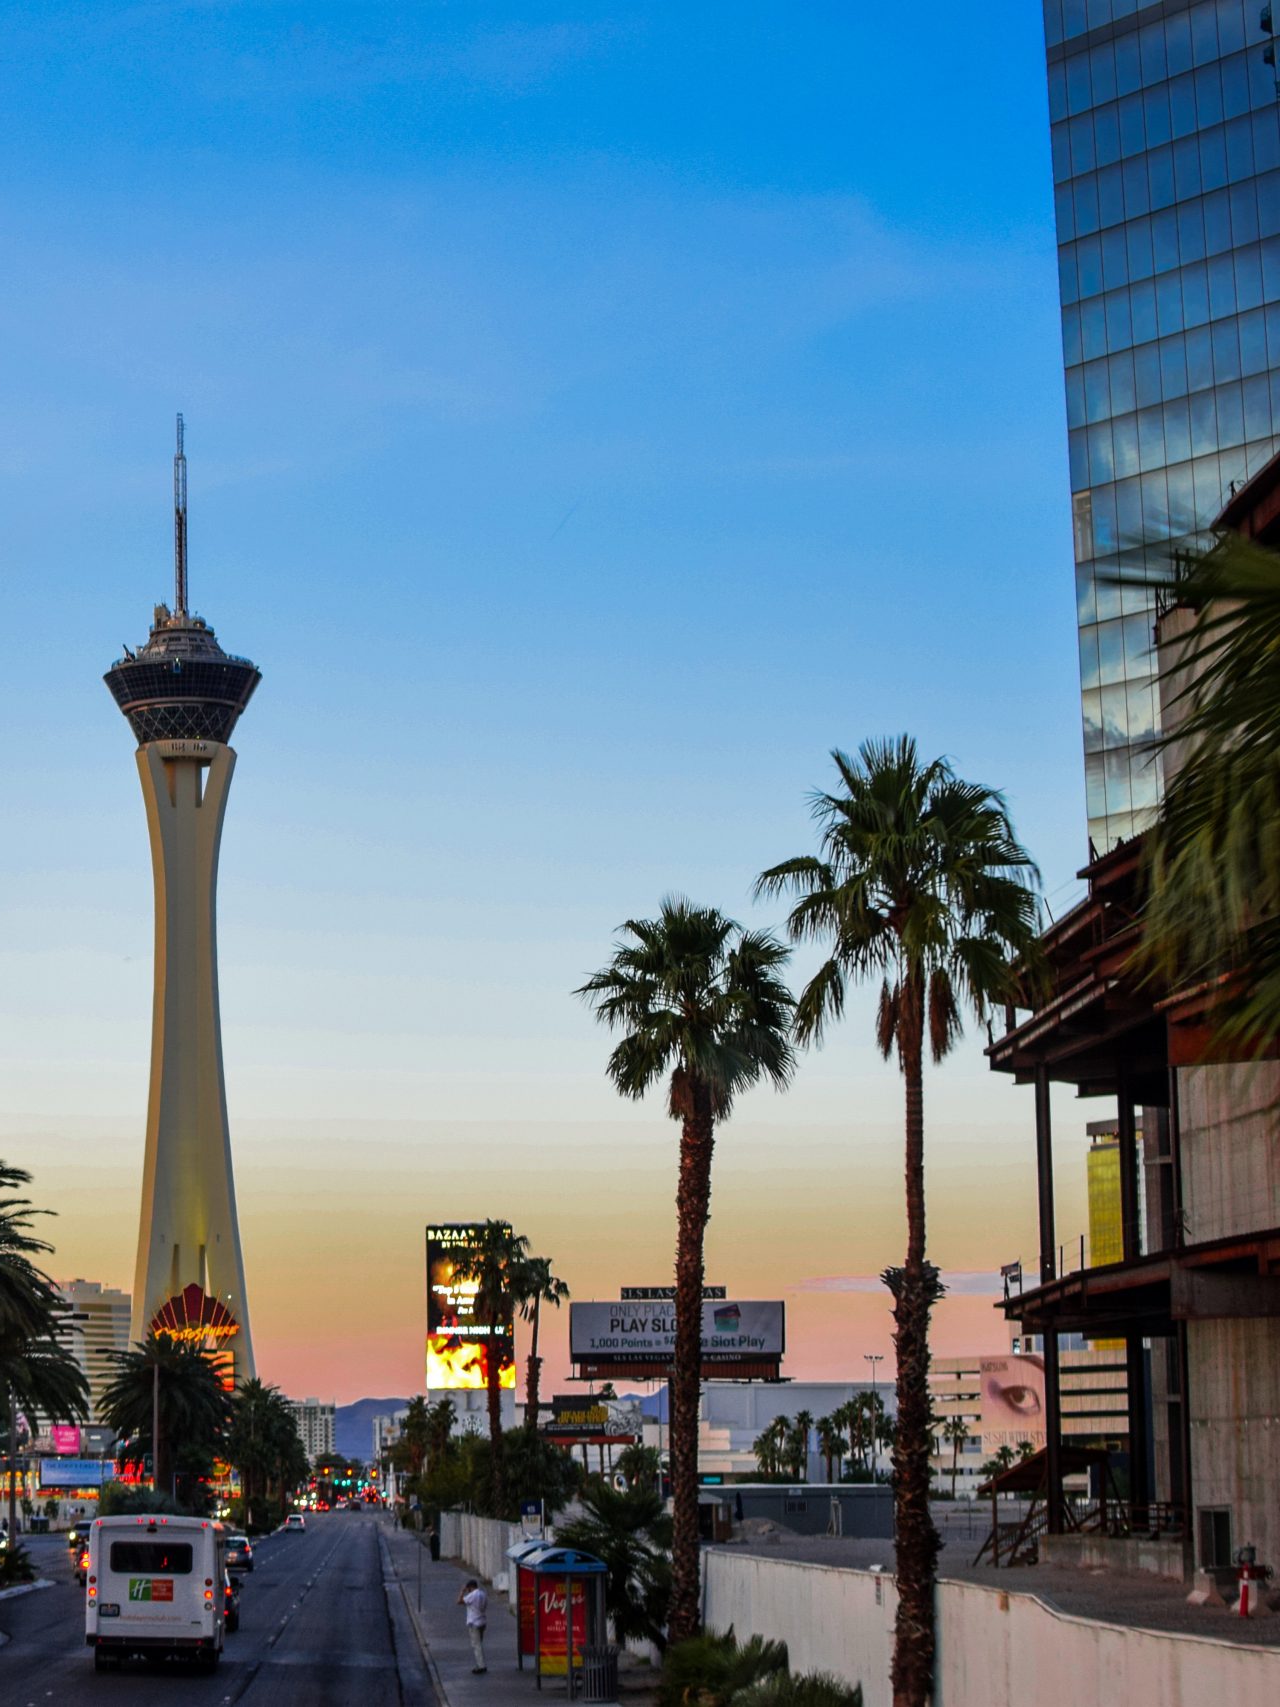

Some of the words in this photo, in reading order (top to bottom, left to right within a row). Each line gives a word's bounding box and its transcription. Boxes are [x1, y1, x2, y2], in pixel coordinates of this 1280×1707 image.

[622, 1288, 643, 1298] SLS
[648, 1288, 671, 1298] LAS
[610, 1305, 639, 1317] ONLY
[644, 1305, 674, 1317] PLAC
[610, 1318, 648, 1333] PLAY
[154, 1325, 240, 1342] SATOSPHERE
[590, 1338, 619, 1349] 1,000
[621, 1338, 653, 1348] Points
[711, 1336, 736, 1348] Slot
[738, 1336, 766, 1350] Play
[445, 1390, 480, 1412] SL
